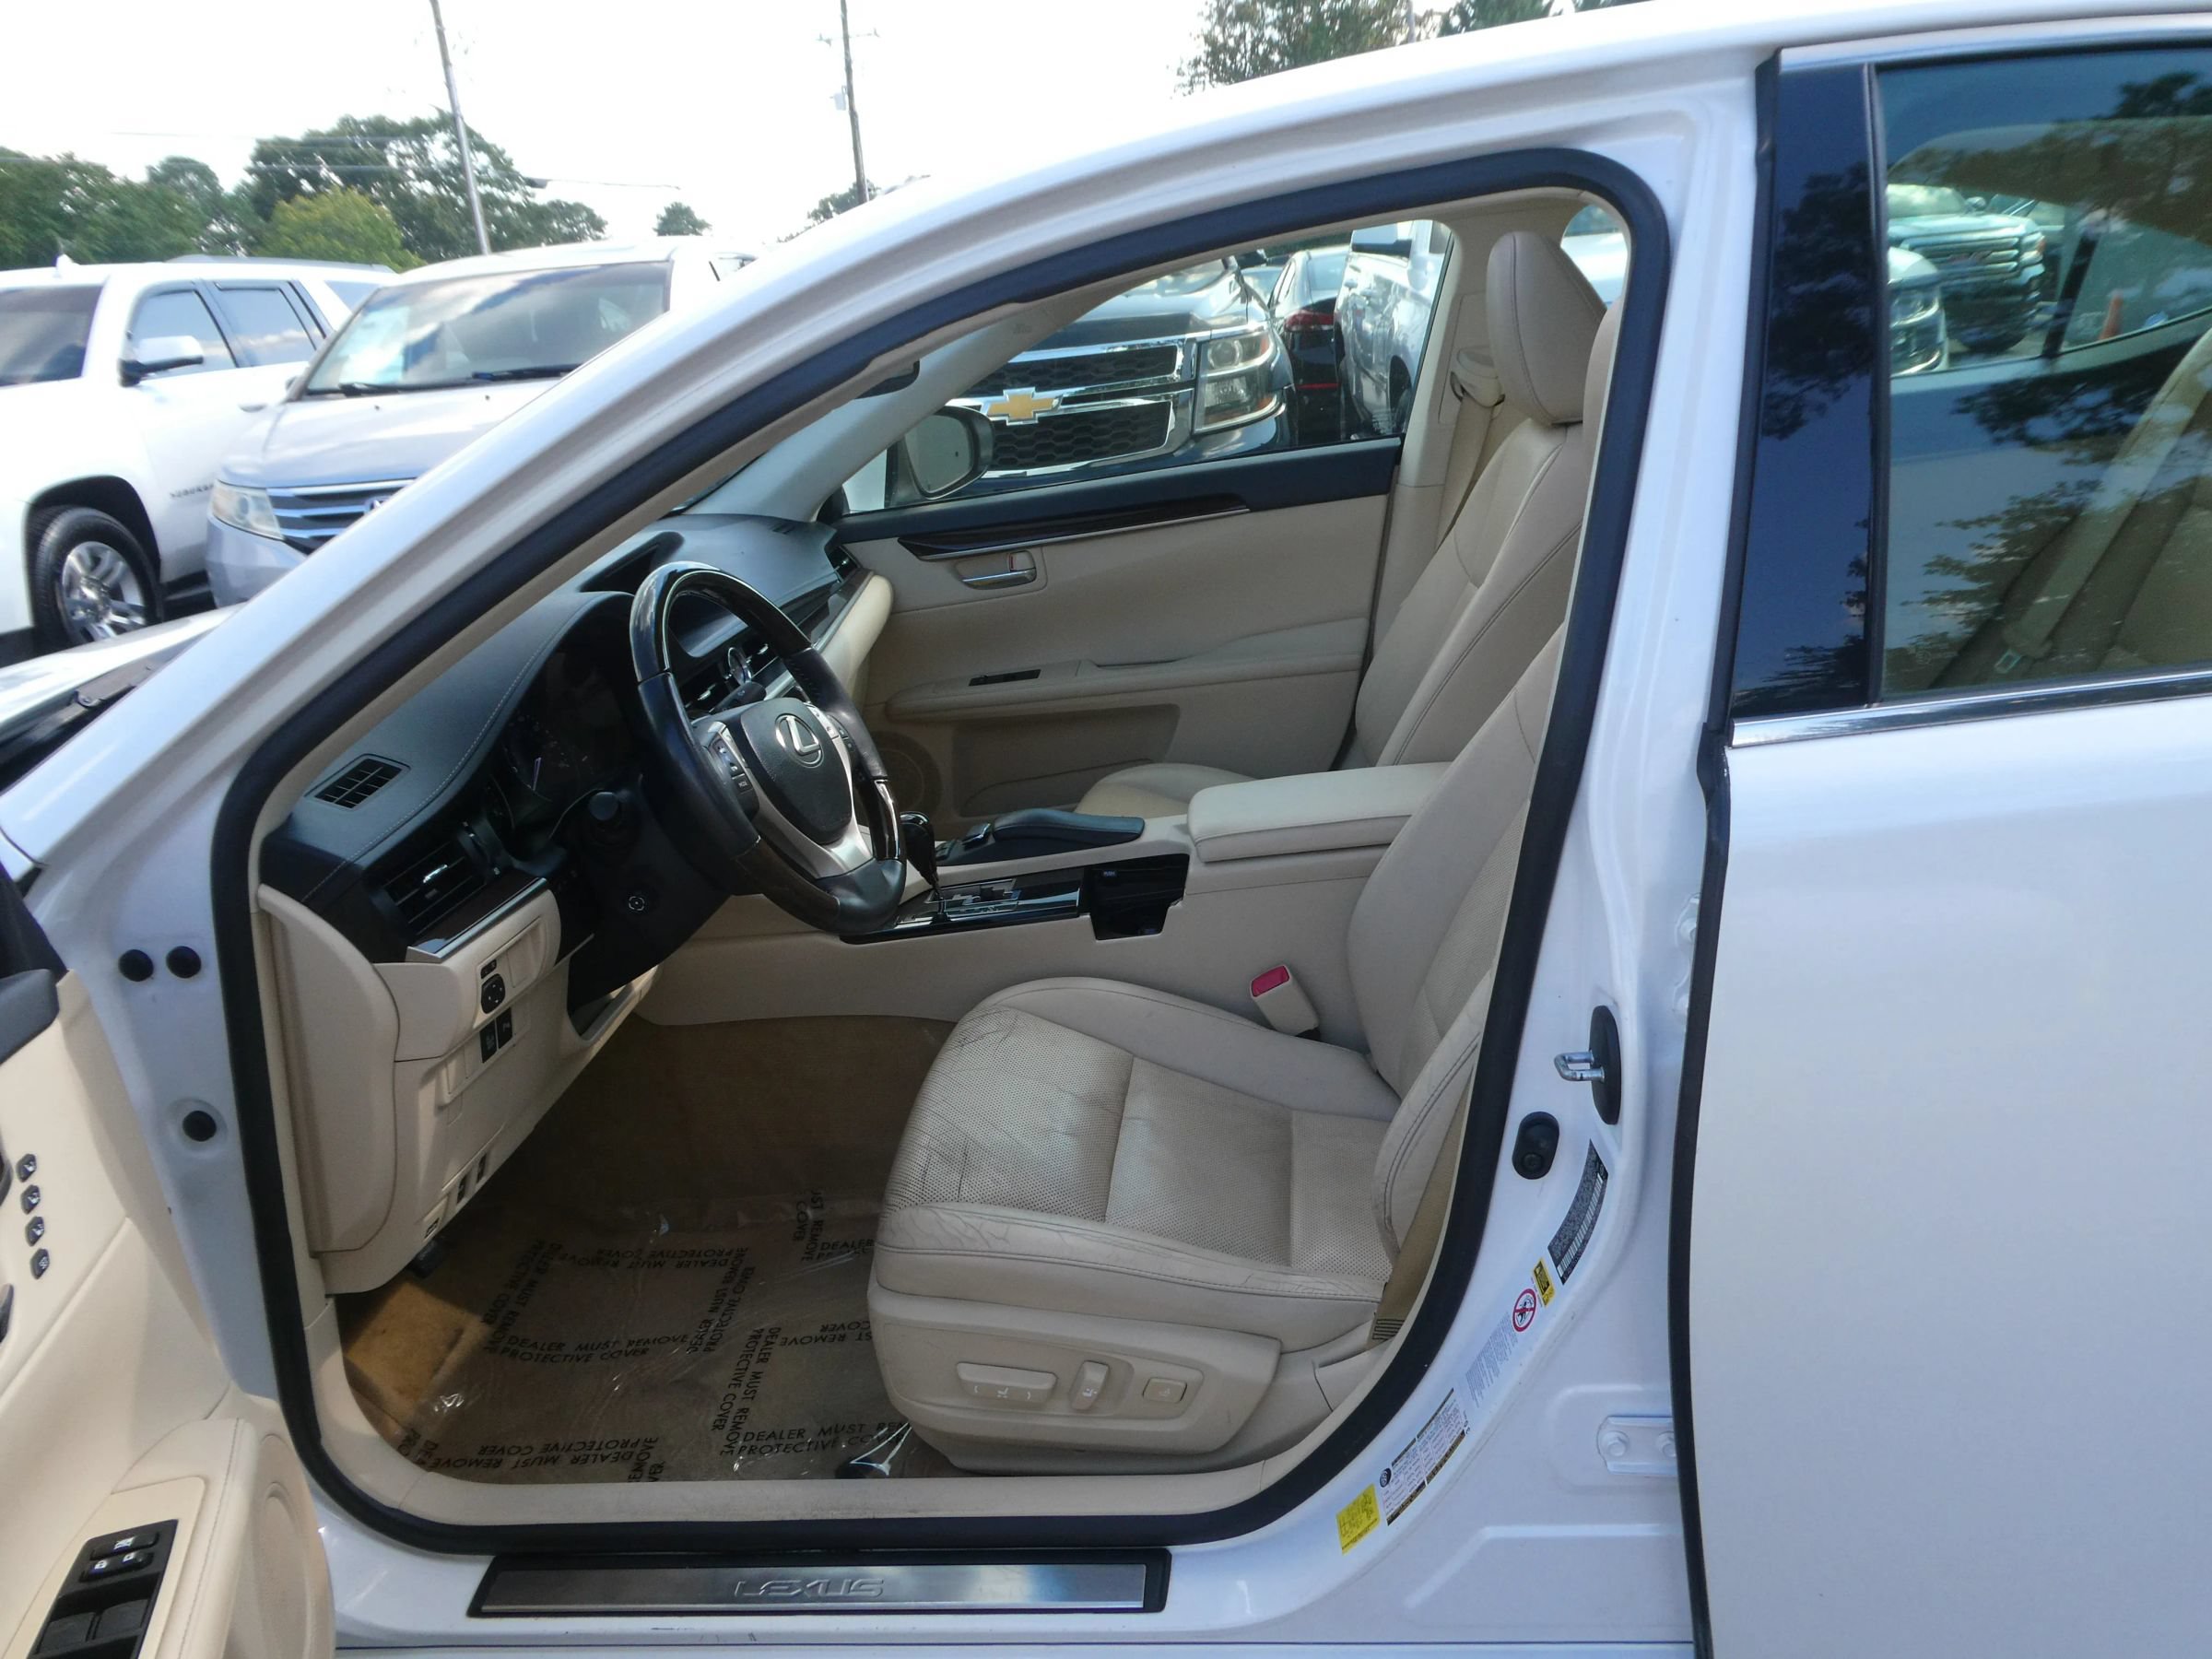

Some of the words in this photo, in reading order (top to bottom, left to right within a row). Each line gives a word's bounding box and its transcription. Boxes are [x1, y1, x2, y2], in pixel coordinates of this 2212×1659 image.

[646, 1248, 735, 1259] PROTECTIVE
[820, 1238, 875, 1252] DEALER
[675, 1258, 729, 1269] DEALER
[507, 1335, 568, 1352] DEALER
[574, 1340, 620, 1352] MUST
[627, 1333, 689, 1347] REMOVE
[756, 1327, 782, 1365] DEALER
[779, 1333, 847, 1347] REMOVE
[500, 1346, 595, 1364] PROTECTIVE
[599, 1347, 650, 1361] COVER
[727, 1327, 765, 1389] PROTECTIVE
[741, 1371, 765, 1401] MUST
[711, 1393, 737, 1431] COVER
[719, 1407, 750, 1456] REMOVE
[743, 1428, 806, 1442] DEALER
[817, 1423, 867, 1438] MUST
[477, 1443, 534, 1456] COVER
[540, 1436, 641, 1453] PROTECTIVE
[736, 1439, 838, 1456] PROTECTIVE
[429, 1457, 504, 1469] REMOVE
[512, 1453, 561, 1469] MUST
[571, 1450, 634, 1466] DEALER
[734, 1578, 885, 1598] LEXUS
